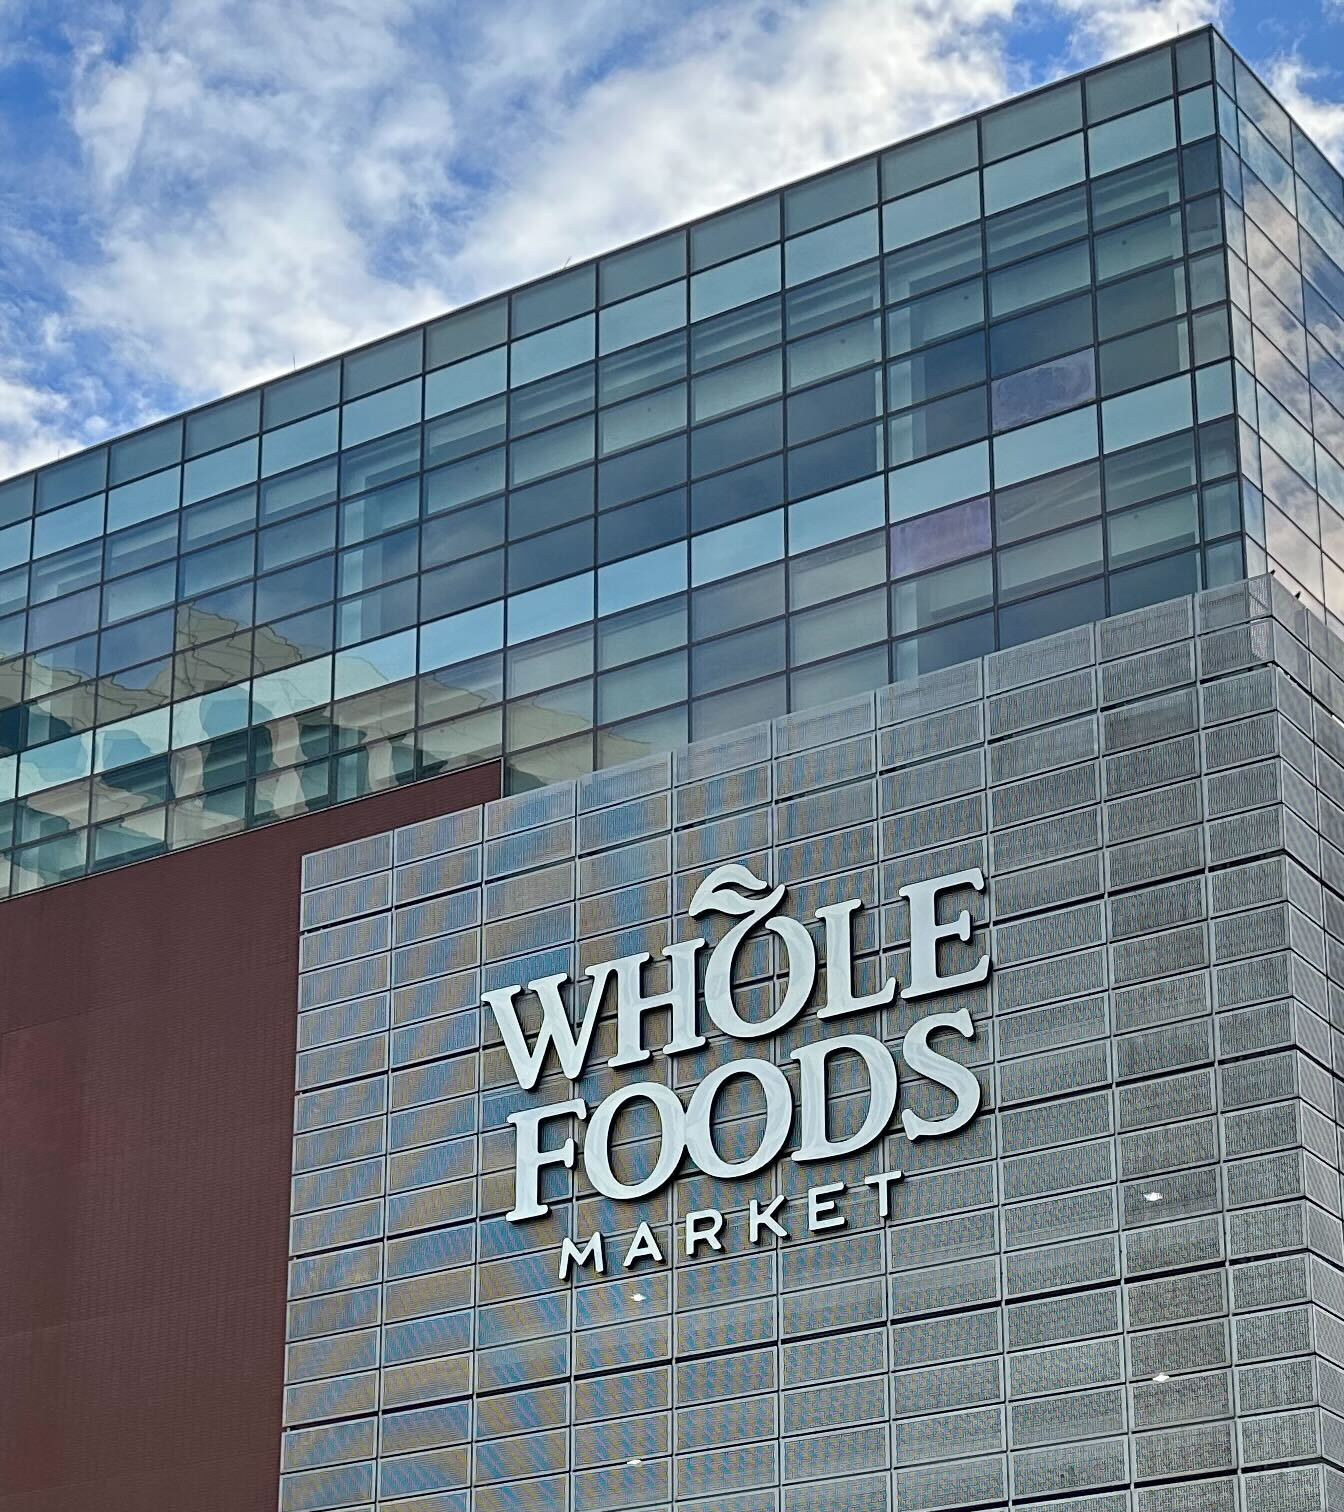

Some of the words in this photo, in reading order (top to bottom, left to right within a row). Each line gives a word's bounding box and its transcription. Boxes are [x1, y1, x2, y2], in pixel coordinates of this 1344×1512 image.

[481, 864, 991, 1090] WHOLE
[505, 1008, 982, 1222] FOODS
[557, 1171, 903, 1280] MARKET
